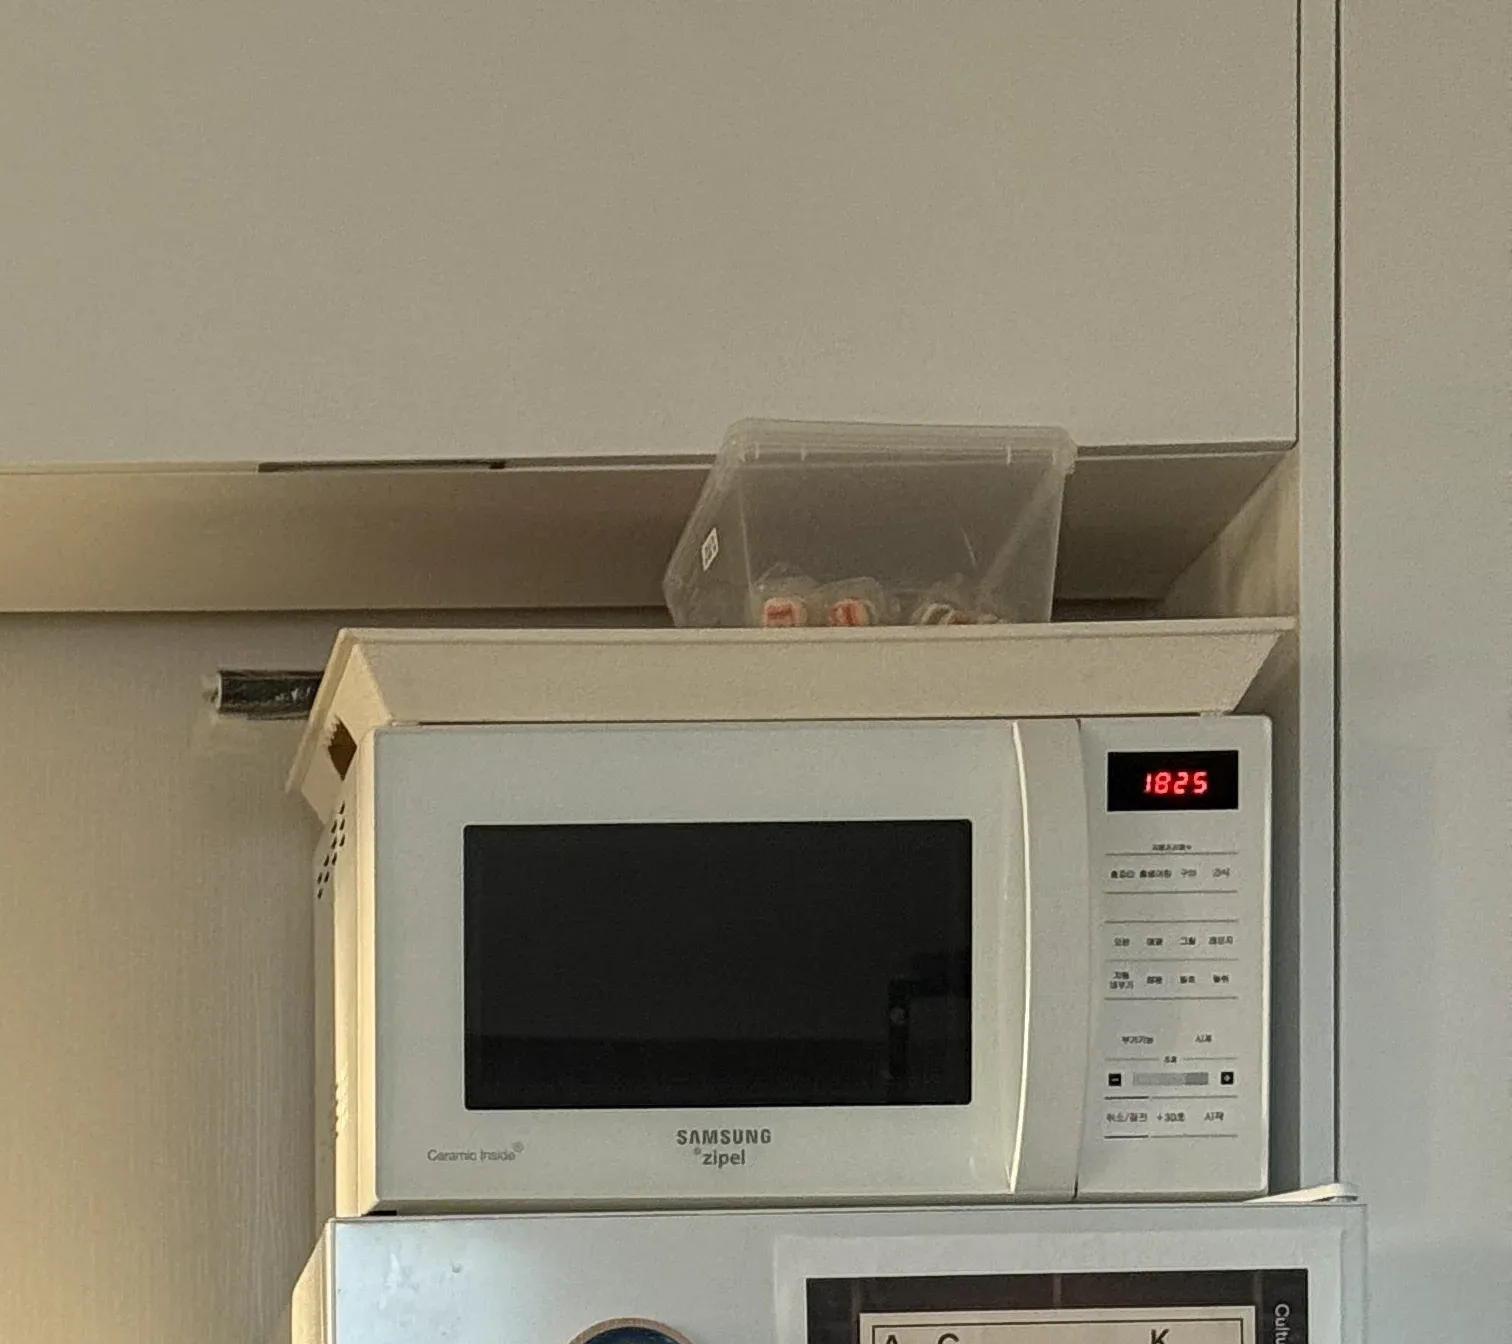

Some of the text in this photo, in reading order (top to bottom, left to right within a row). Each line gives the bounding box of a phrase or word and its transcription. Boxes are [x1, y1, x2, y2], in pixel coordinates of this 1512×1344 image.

[1143, 770, 1209, 795] 1825
[676, 1128, 772, 1145] SAMSUNG
[427, 1147, 477, 1162] Ceramic
